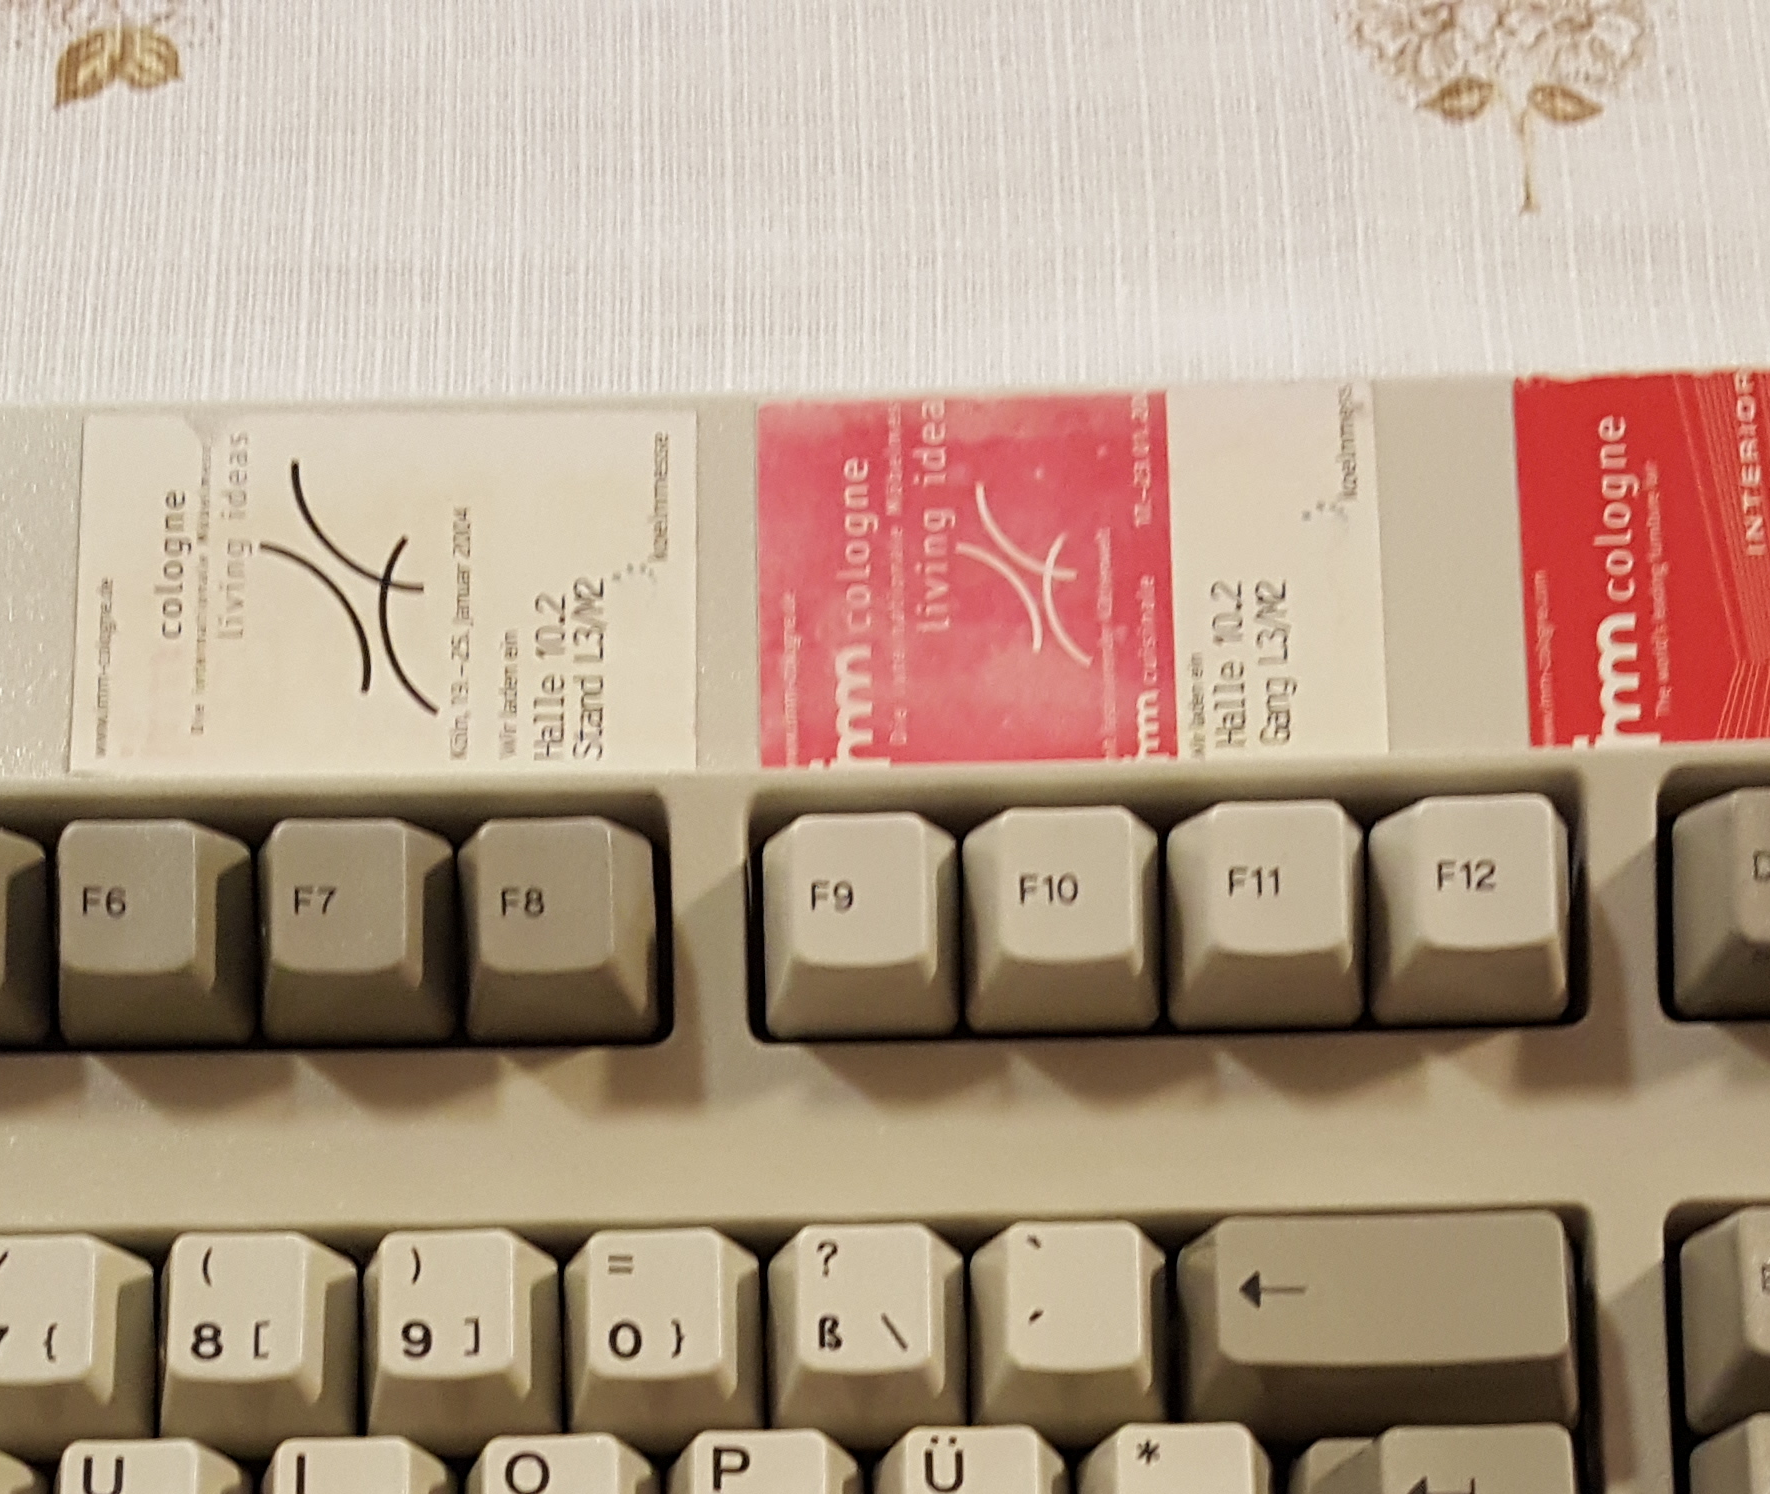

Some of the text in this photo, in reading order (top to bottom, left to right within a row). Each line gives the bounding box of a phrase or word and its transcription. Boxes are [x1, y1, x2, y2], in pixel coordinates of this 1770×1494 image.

[1594, 414, 1639, 602] cologne
[217, 431, 252, 639] living ideas
[836, 457, 880, 633] cologne
[154, 489, 191, 639] cologne
[916, 508, 956, 633] living
[501, 629, 518, 660] ein
[1188, 652, 1204, 678] ein
[1210, 580, 1247, 748] Halle 10.2
[499, 664, 518, 718] laden
[533, 592, 566, 761] Halle 10.2
[572, 675, 604, 761] Stand
[1189, 684, 1204, 728] laden
[1259, 677, 1296, 745] Gang
[810, 880, 855, 911] F9
[1018, 873, 1079, 905] F10
[1227, 866, 1280, 897] F11
[1436, 859, 1496, 891] F12
[82, 886, 127, 920] F6
[293, 885, 337, 916] F7
[500, 887, 545, 918] F8
[190, 1321, 224, 1362] 8
[400, 1319, 433, 1359] 9
[712, 1445, 751, 1493] P
[923, 1436, 964, 1494] Ü
